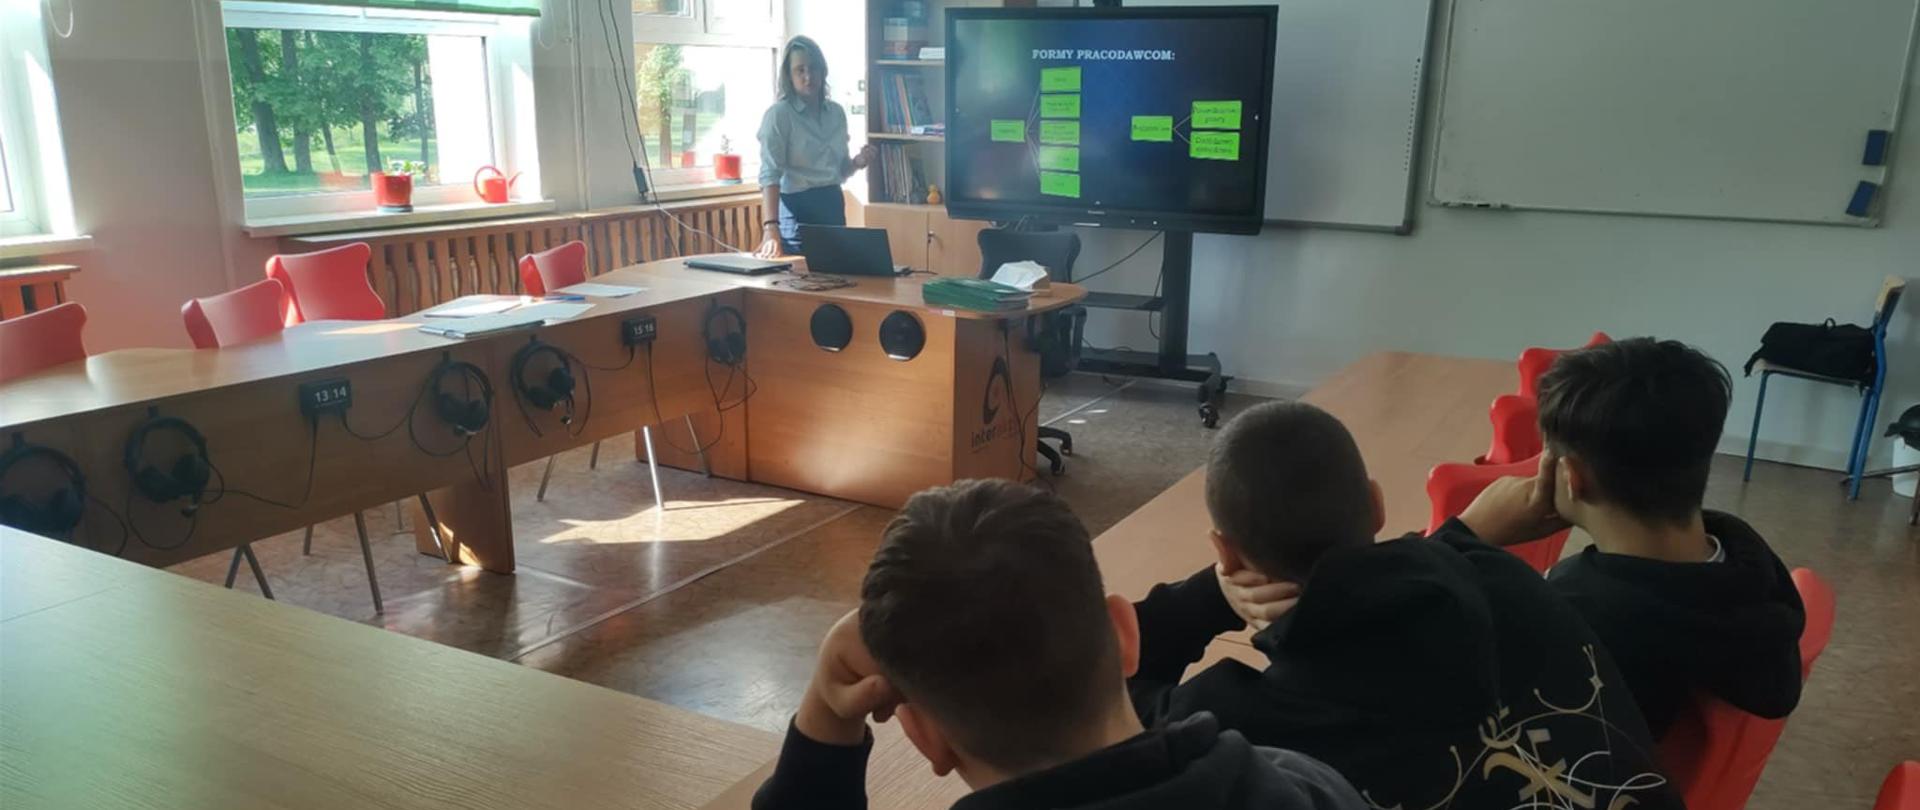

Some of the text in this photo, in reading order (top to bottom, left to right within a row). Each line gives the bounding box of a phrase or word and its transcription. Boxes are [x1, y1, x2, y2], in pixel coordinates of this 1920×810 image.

[1032, 49, 1176, 61] FORMY PRACODAWCOM:
[314, 386, 347, 403] 13 14
